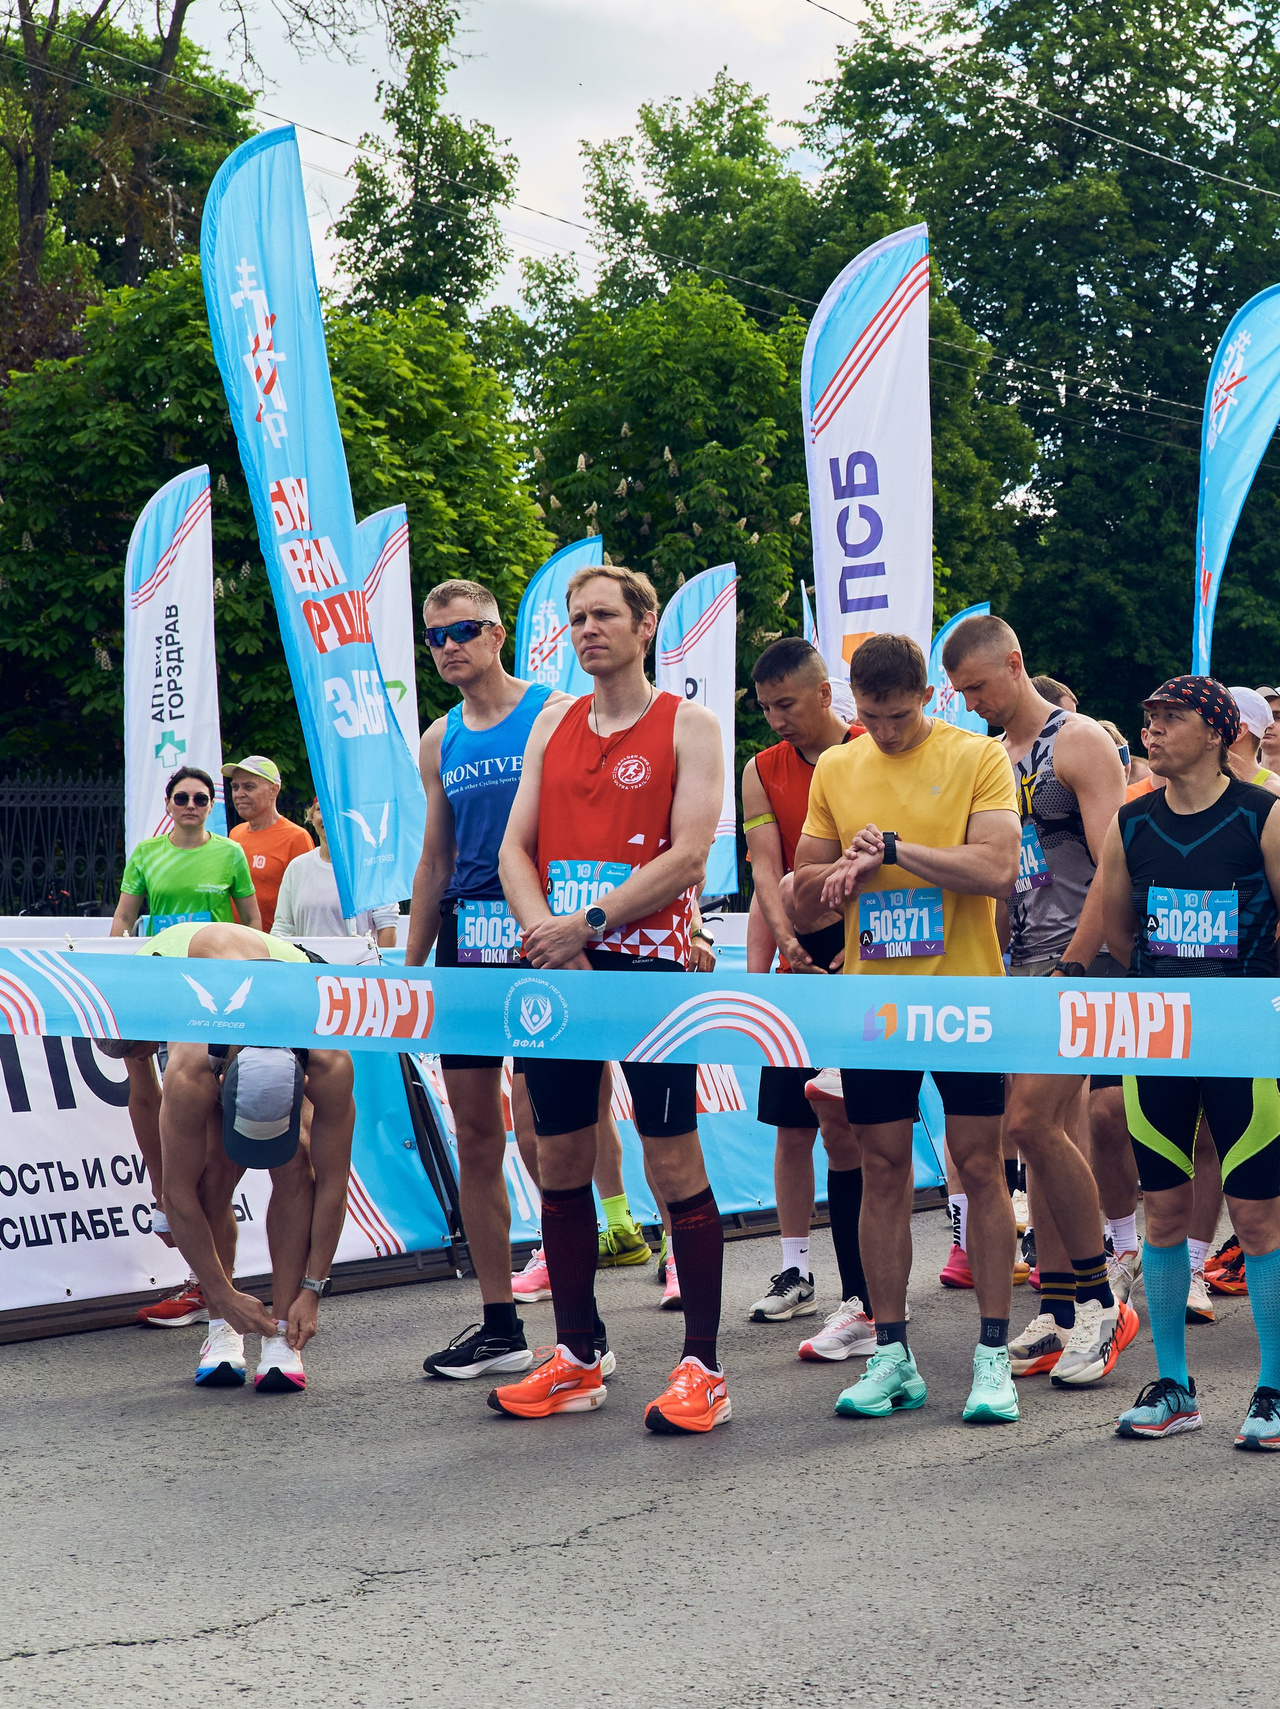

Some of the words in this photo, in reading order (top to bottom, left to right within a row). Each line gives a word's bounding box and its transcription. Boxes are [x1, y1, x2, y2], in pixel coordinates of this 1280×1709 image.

[829, 450, 889, 614] ПСБ
[165, 604, 185, 721] ГОРЗДРАВ
[862, 934, 871, 945] А
[869, 907, 930, 943] 50371
[1147, 916, 1158, 928] А
[1156, 907, 1229, 944] 50284
[187, 1019, 210, 1027] ЛИГА
[211, 1020, 246, 1029] ГЕРОЕВ
[314, 974, 434, 1040] СТАРТ
[906, 1004, 993, 1043] ПСБ
[1058, 990, 1192, 1059] СТАРТ
[512, 1039, 545, 1049] ВФЛА
[0, 1160, 79, 1197] ОСТЬ
[81, 1157, 107, 1190] И
[0, 1206, 130, 1250] СШТАБЕ
